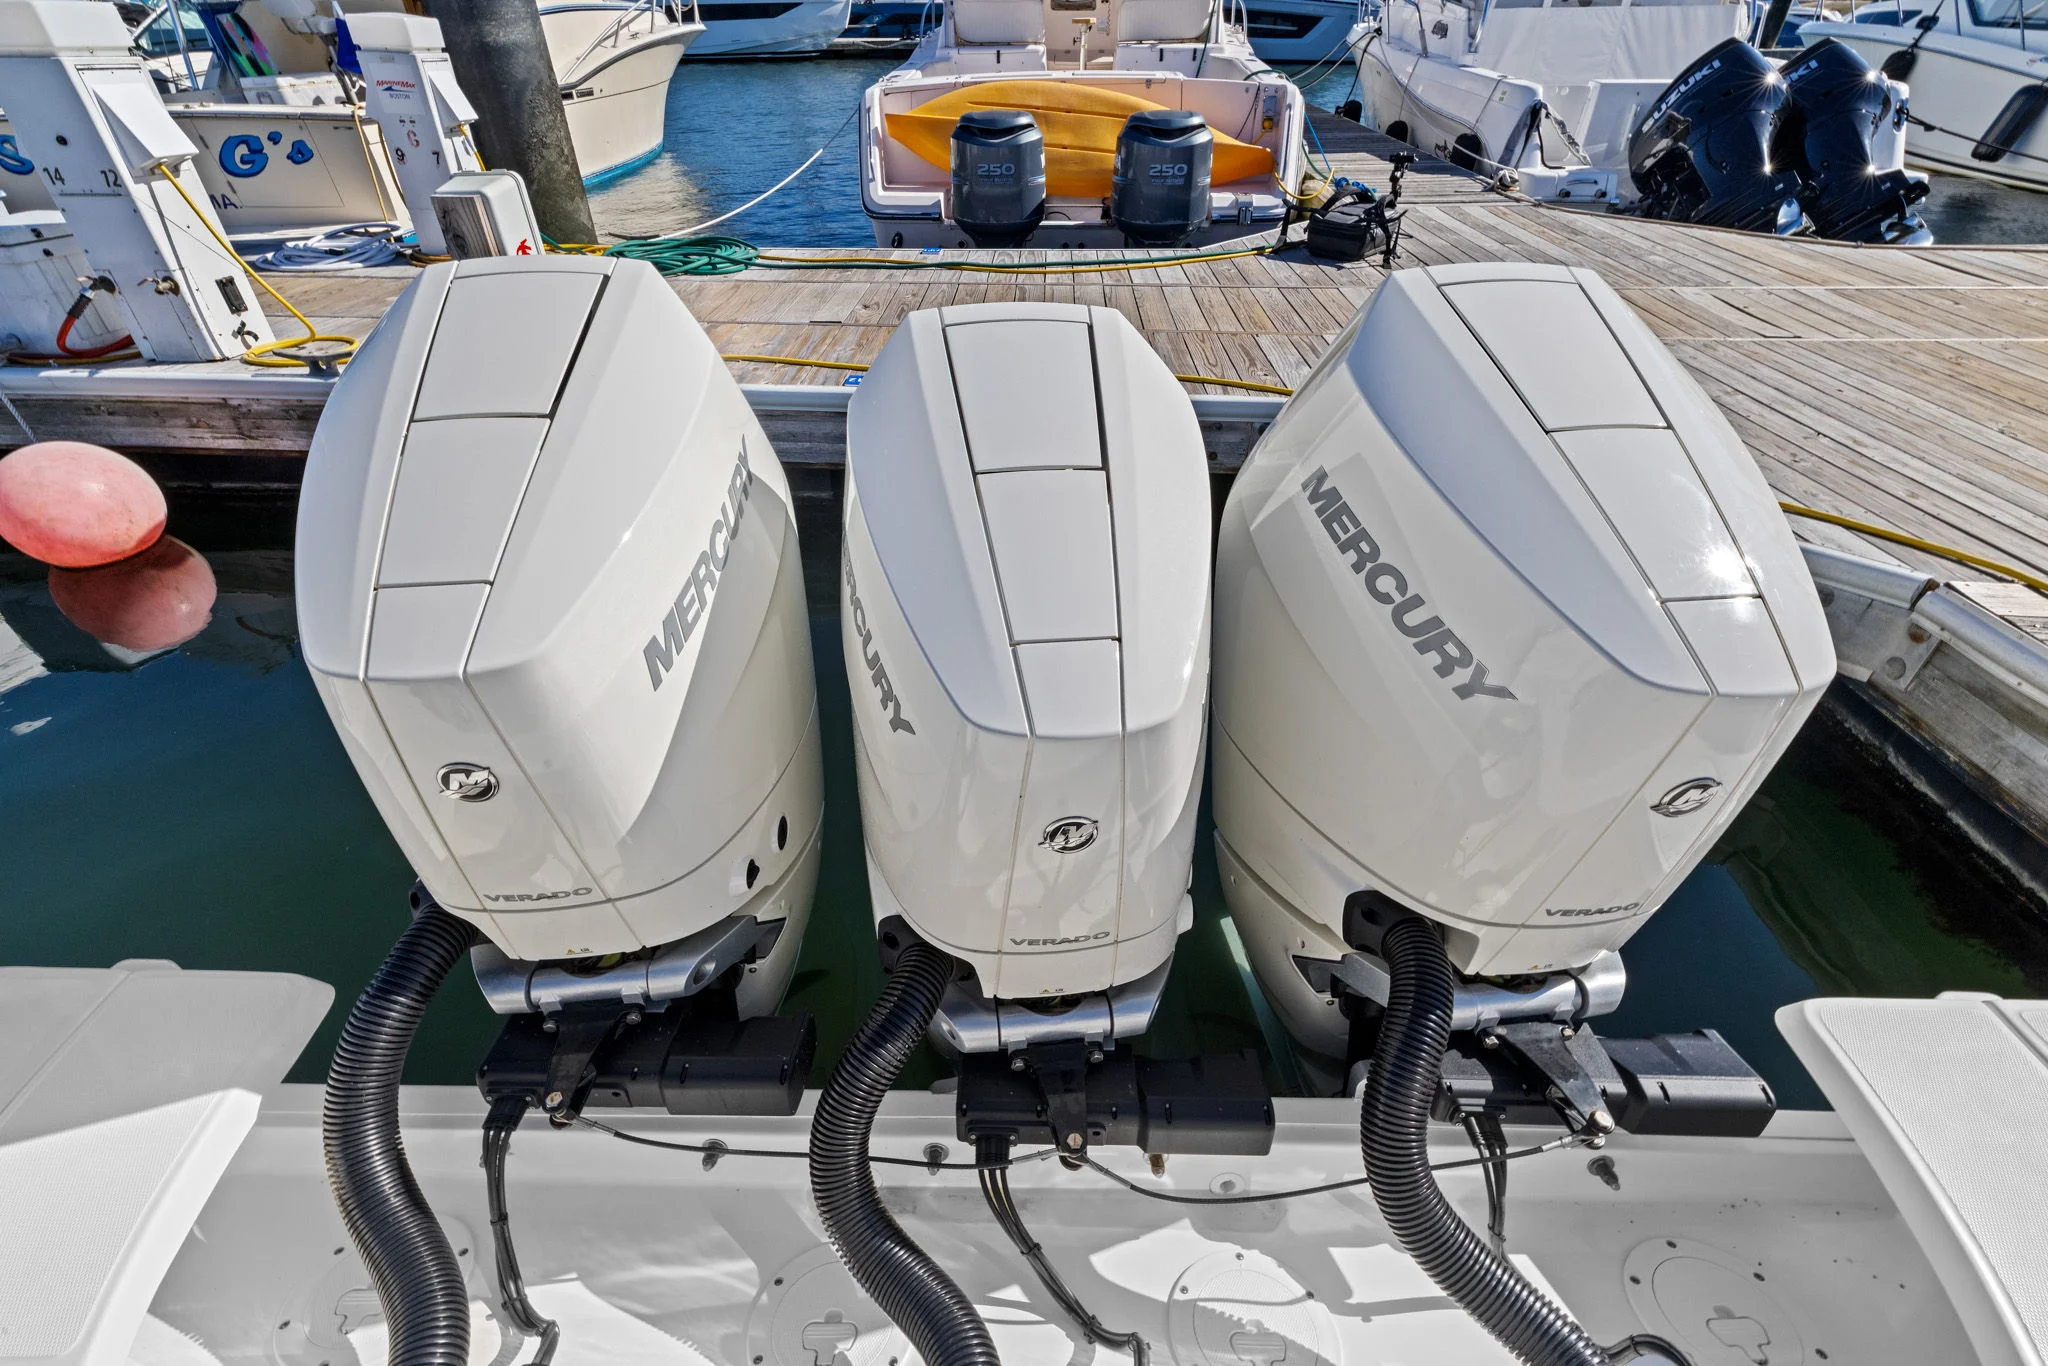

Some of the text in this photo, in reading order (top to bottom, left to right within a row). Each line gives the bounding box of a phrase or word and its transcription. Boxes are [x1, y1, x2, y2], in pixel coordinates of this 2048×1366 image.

[1642, 59, 1721, 133] SUZUKI
[218, 130, 315, 178] G's
[395, 147, 405, 162] 9
[431, 150, 441, 165] 7
[43, 166, 66, 187] 14
[976, 163, 1016, 176] 250
[1148, 163, 1188, 176] 250
[100, 169, 122, 188] 12
[642, 434, 753, 691] MERCURY
[1300, 464, 1518, 700] MERCURY
[483, 887, 593, 902] VERADO
[1545, 902, 1640, 917] VERADO
[1010, 931, 1110, 946] VERADO
